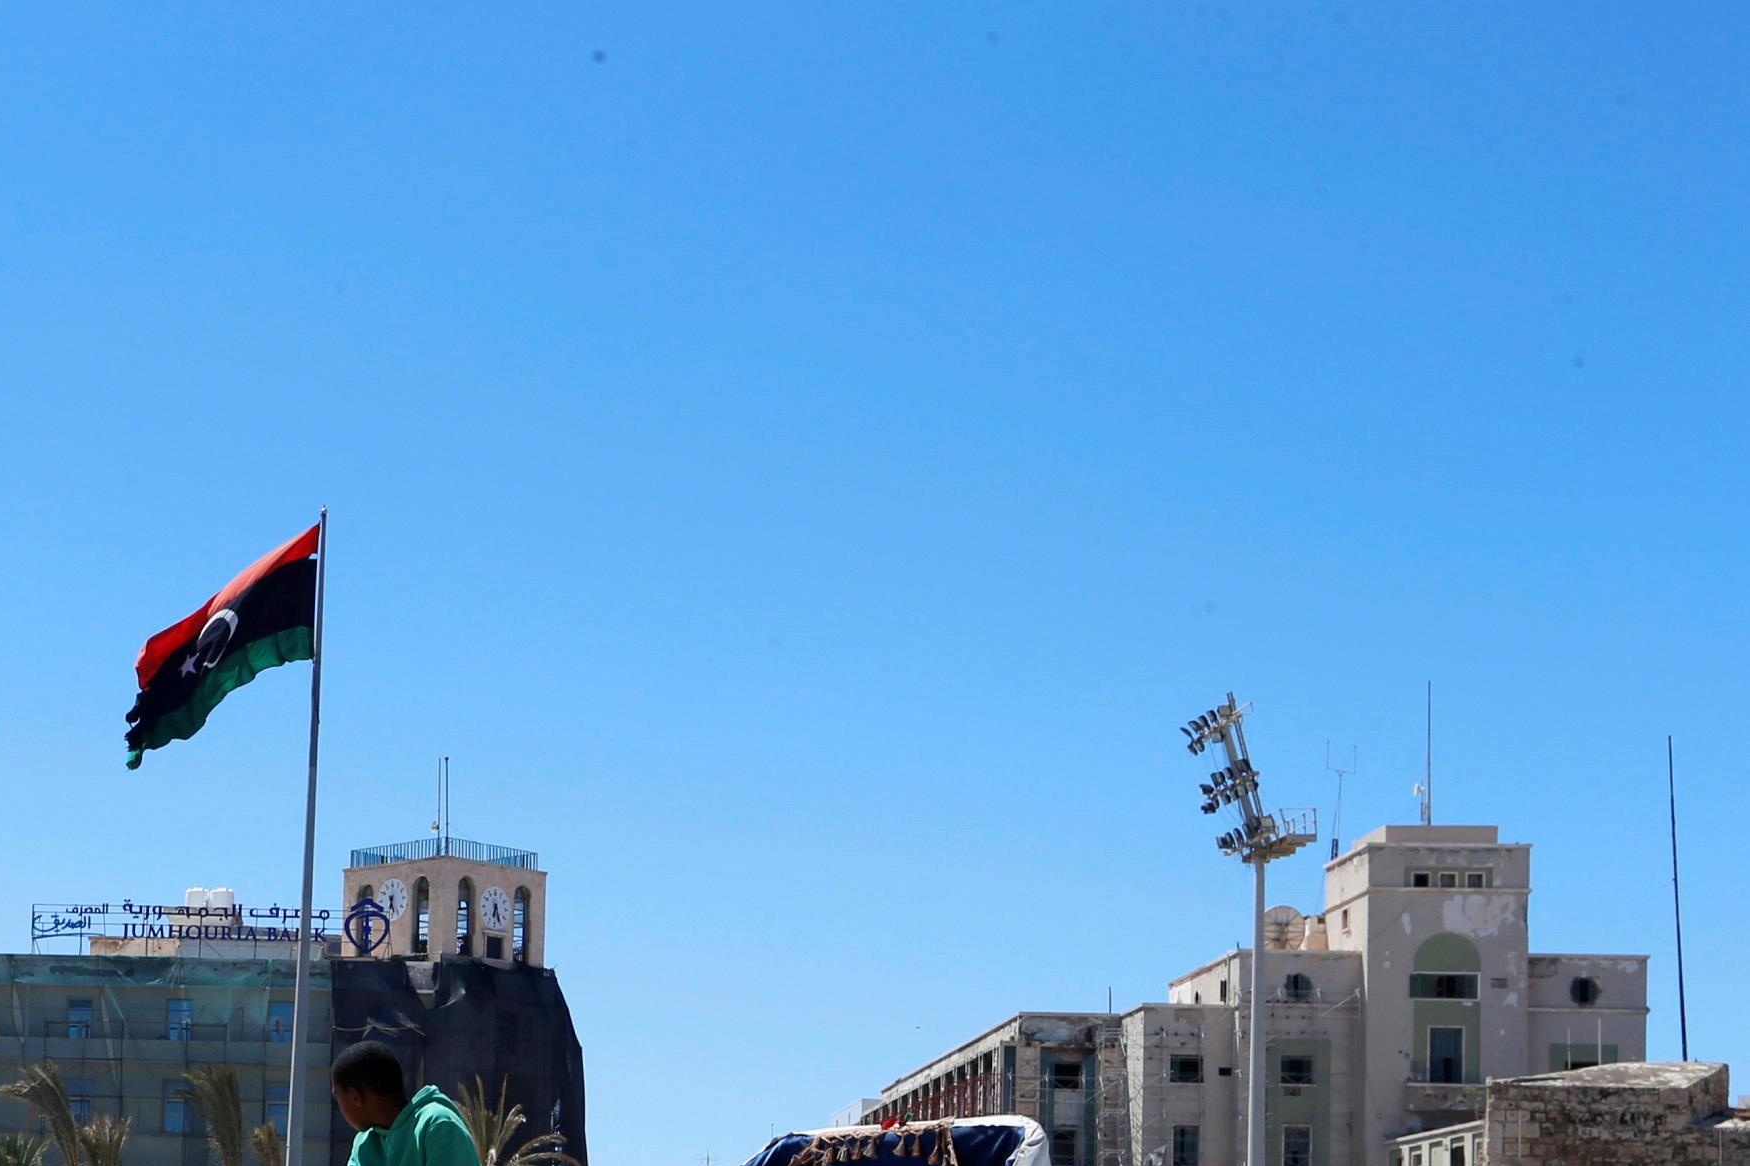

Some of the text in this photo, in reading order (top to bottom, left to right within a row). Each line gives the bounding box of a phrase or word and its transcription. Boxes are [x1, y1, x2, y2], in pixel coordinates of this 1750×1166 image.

[66, 903, 109, 916] المصرف
[122, 898, 242, 920] الجمهورية
[122, 923, 327, 942] JUMHOURIA BAK
